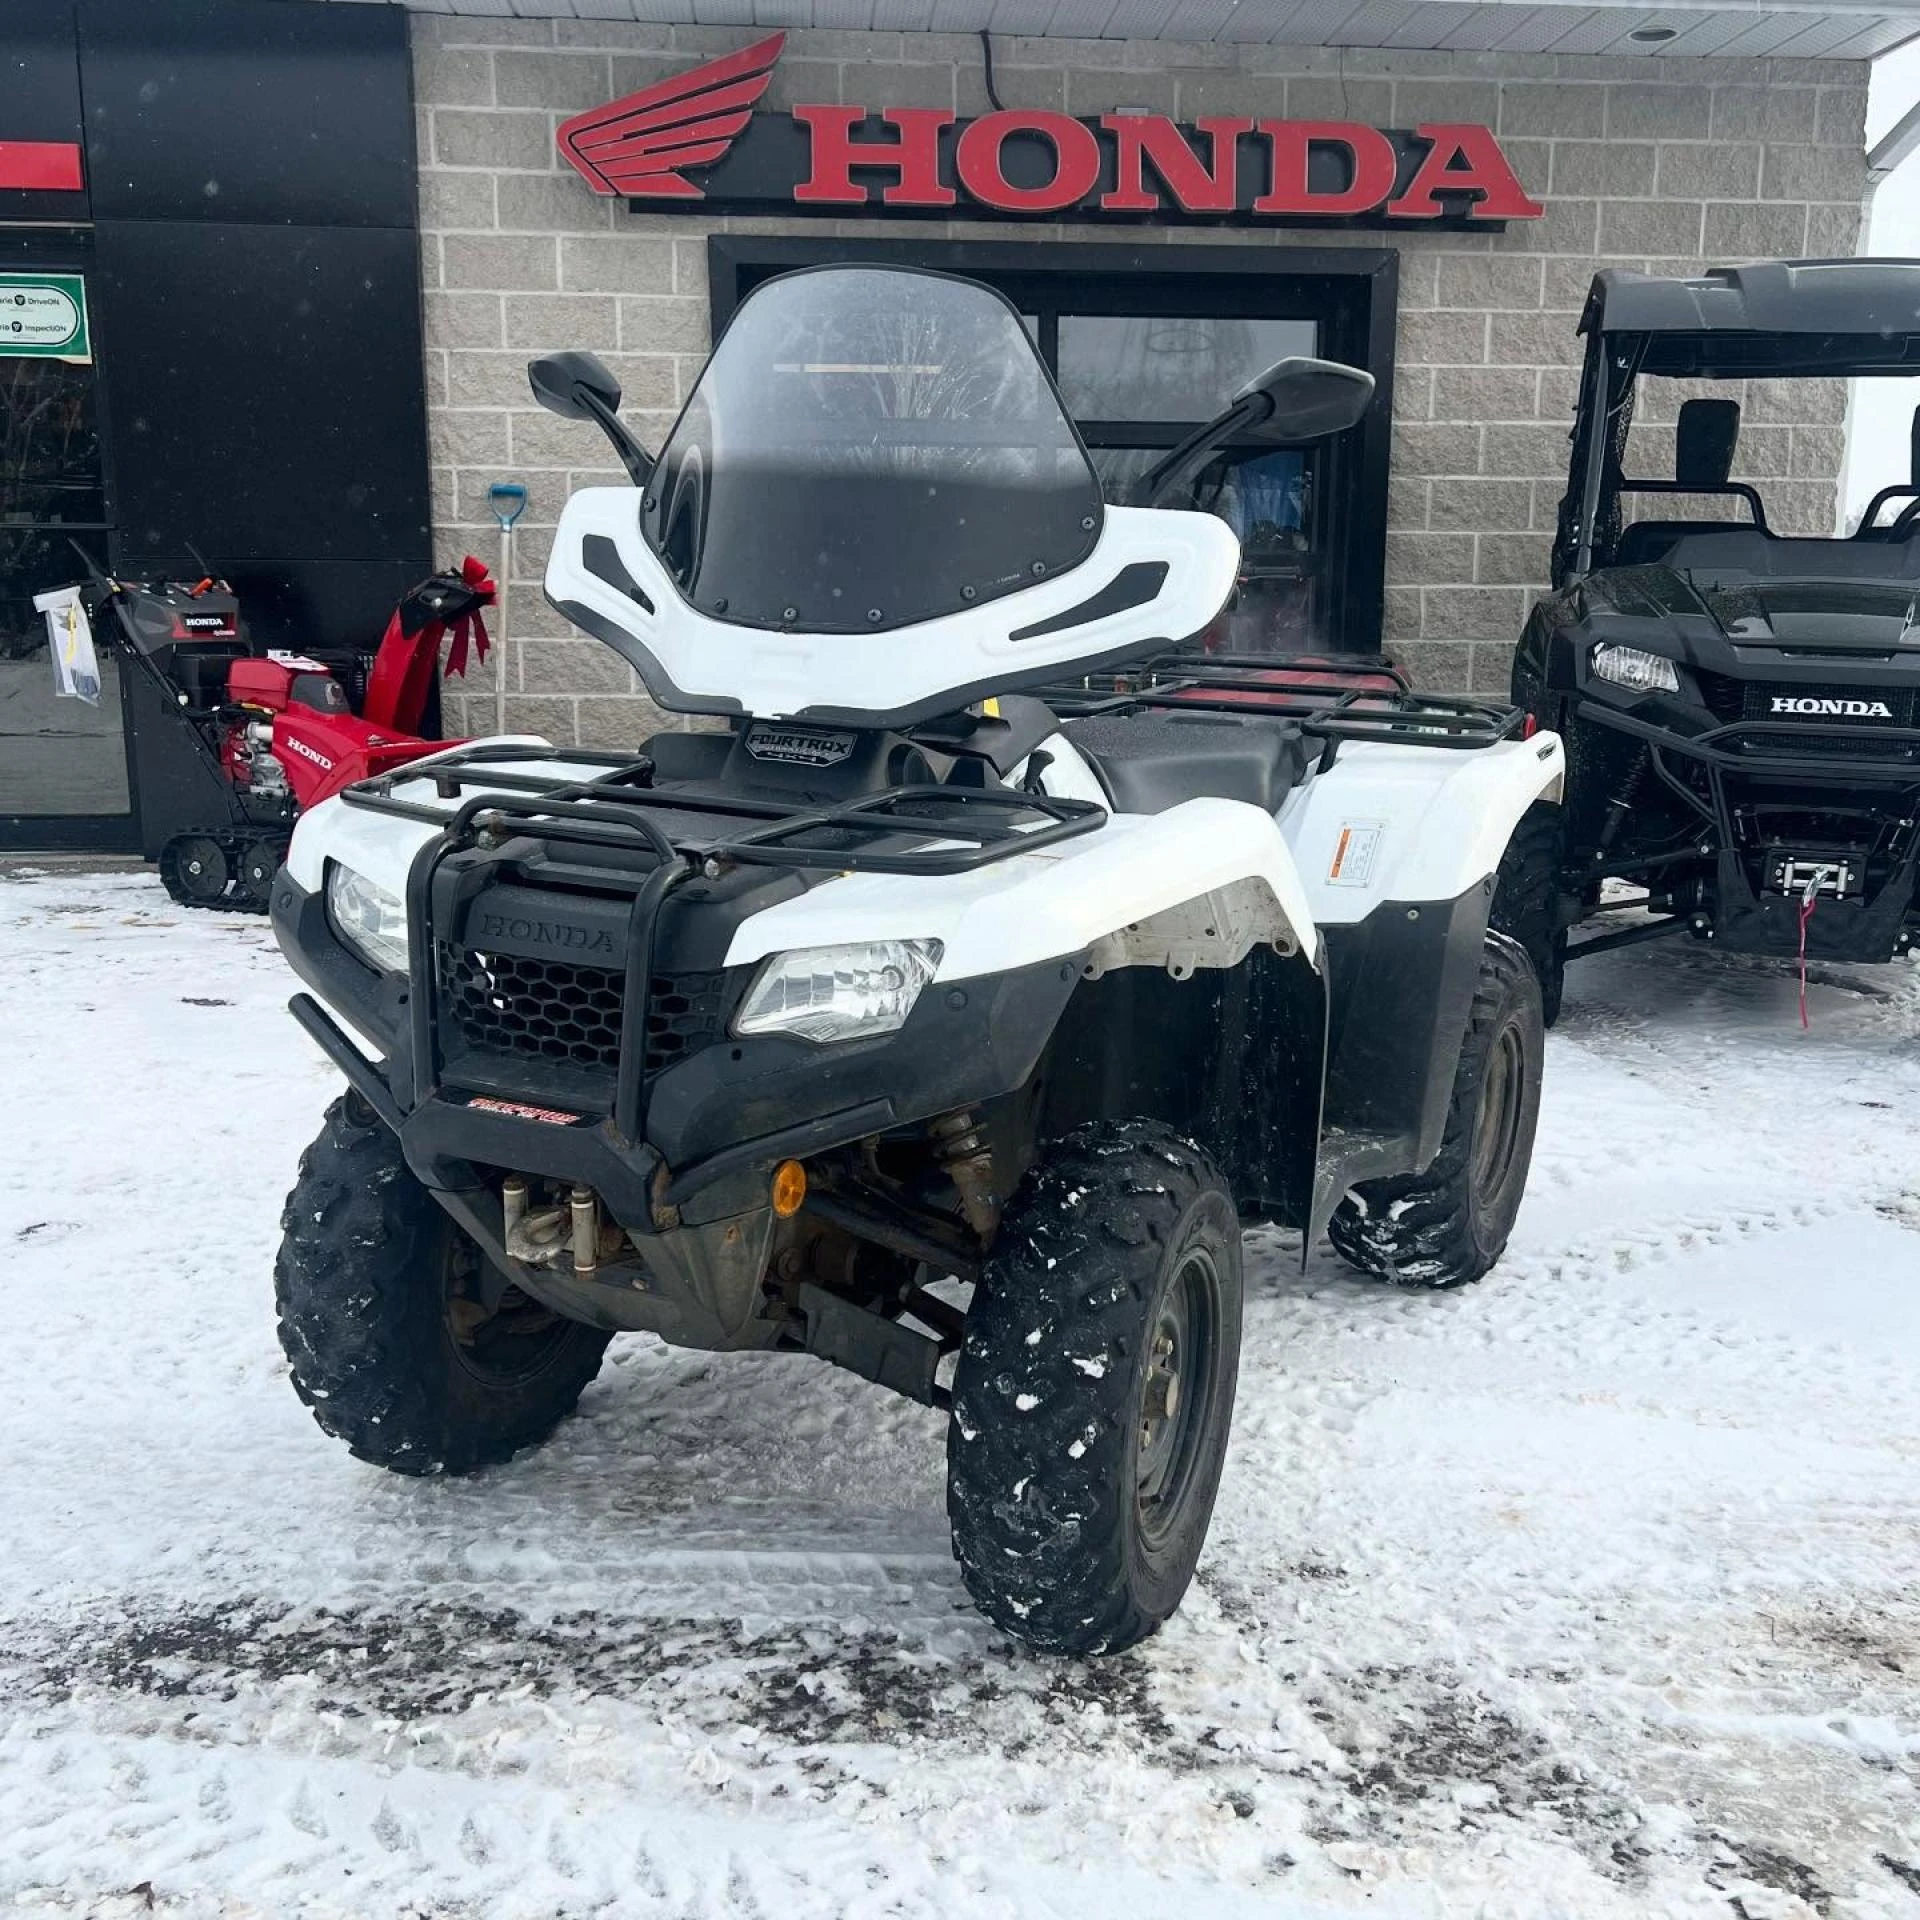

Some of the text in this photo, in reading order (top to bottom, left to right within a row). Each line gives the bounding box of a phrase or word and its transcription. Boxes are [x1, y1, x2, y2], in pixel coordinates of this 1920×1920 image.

[792, 103, 1545, 219] HONDA
[185, 618, 224, 626] HONDA
[1770, 697, 1893, 717] HONDA
[750, 734, 847, 754] FOURTRAX
[480, 914, 614, 952] HONDA
